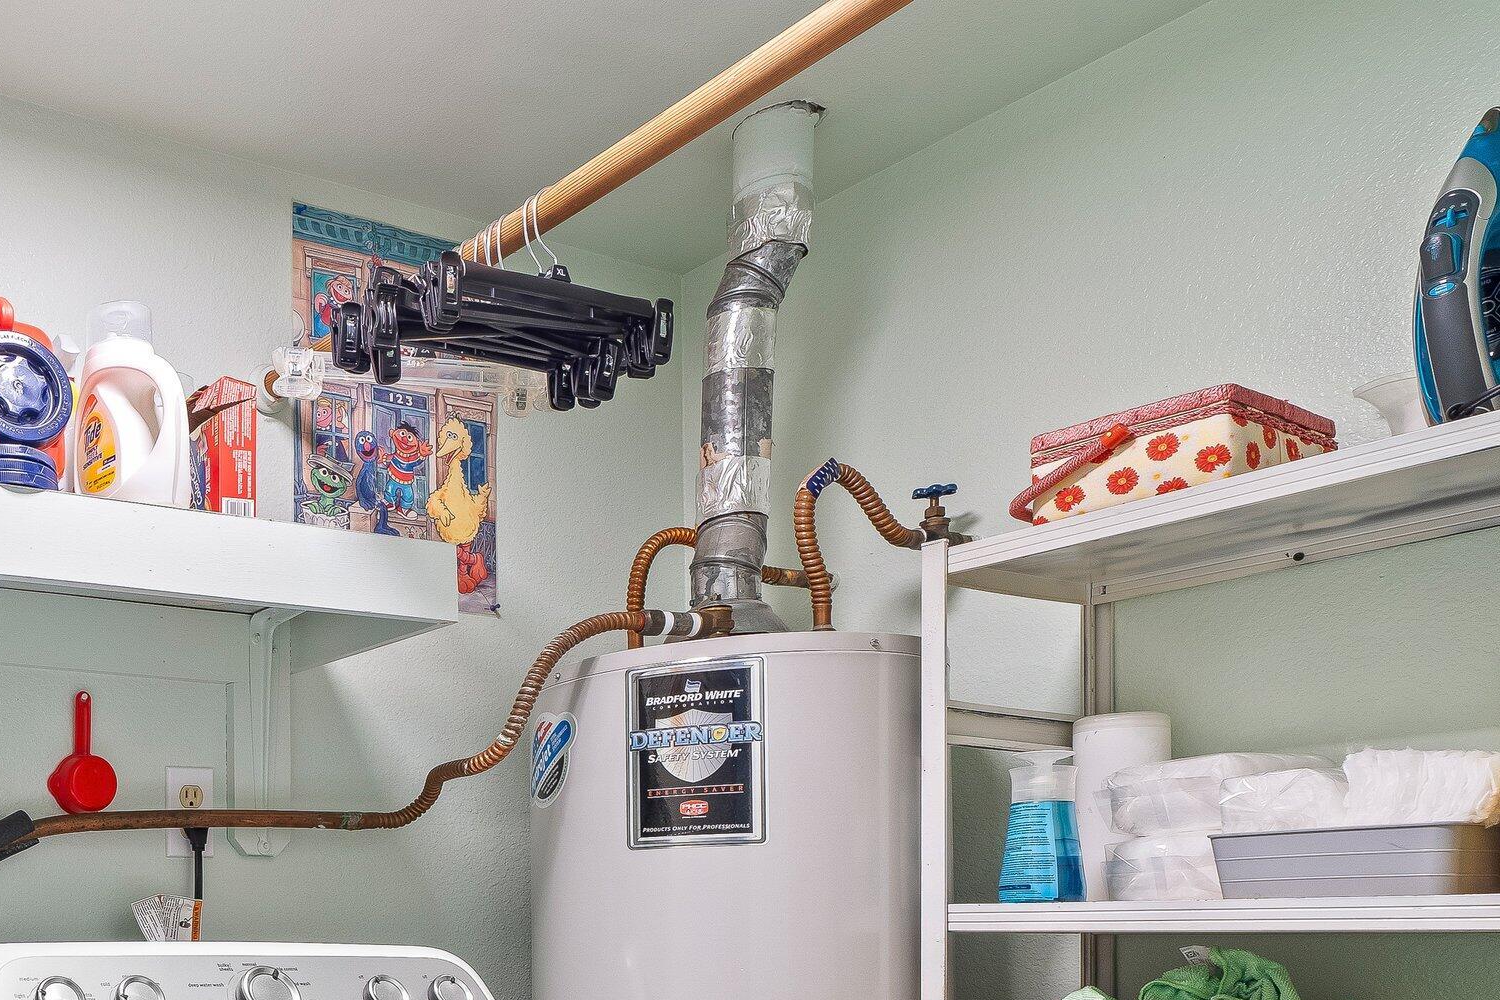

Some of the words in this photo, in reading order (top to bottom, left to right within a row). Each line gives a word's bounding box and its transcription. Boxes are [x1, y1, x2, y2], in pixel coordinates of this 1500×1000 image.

[556, 267, 567, 278] XL
[388, 392, 413, 407] 123
[84, 421, 102, 452] Tide
[646, 692, 702, 706] BRADFORD
[705, 689, 743, 700] WHITE
[652, 699, 733, 711] CORPORATION
[631, 720, 763, 751] DEFENDER
[647, 753, 689, 764] SAFETY
[648, 788, 695, 797] ENERGY
[703, 786, 744, 794] SAVER
